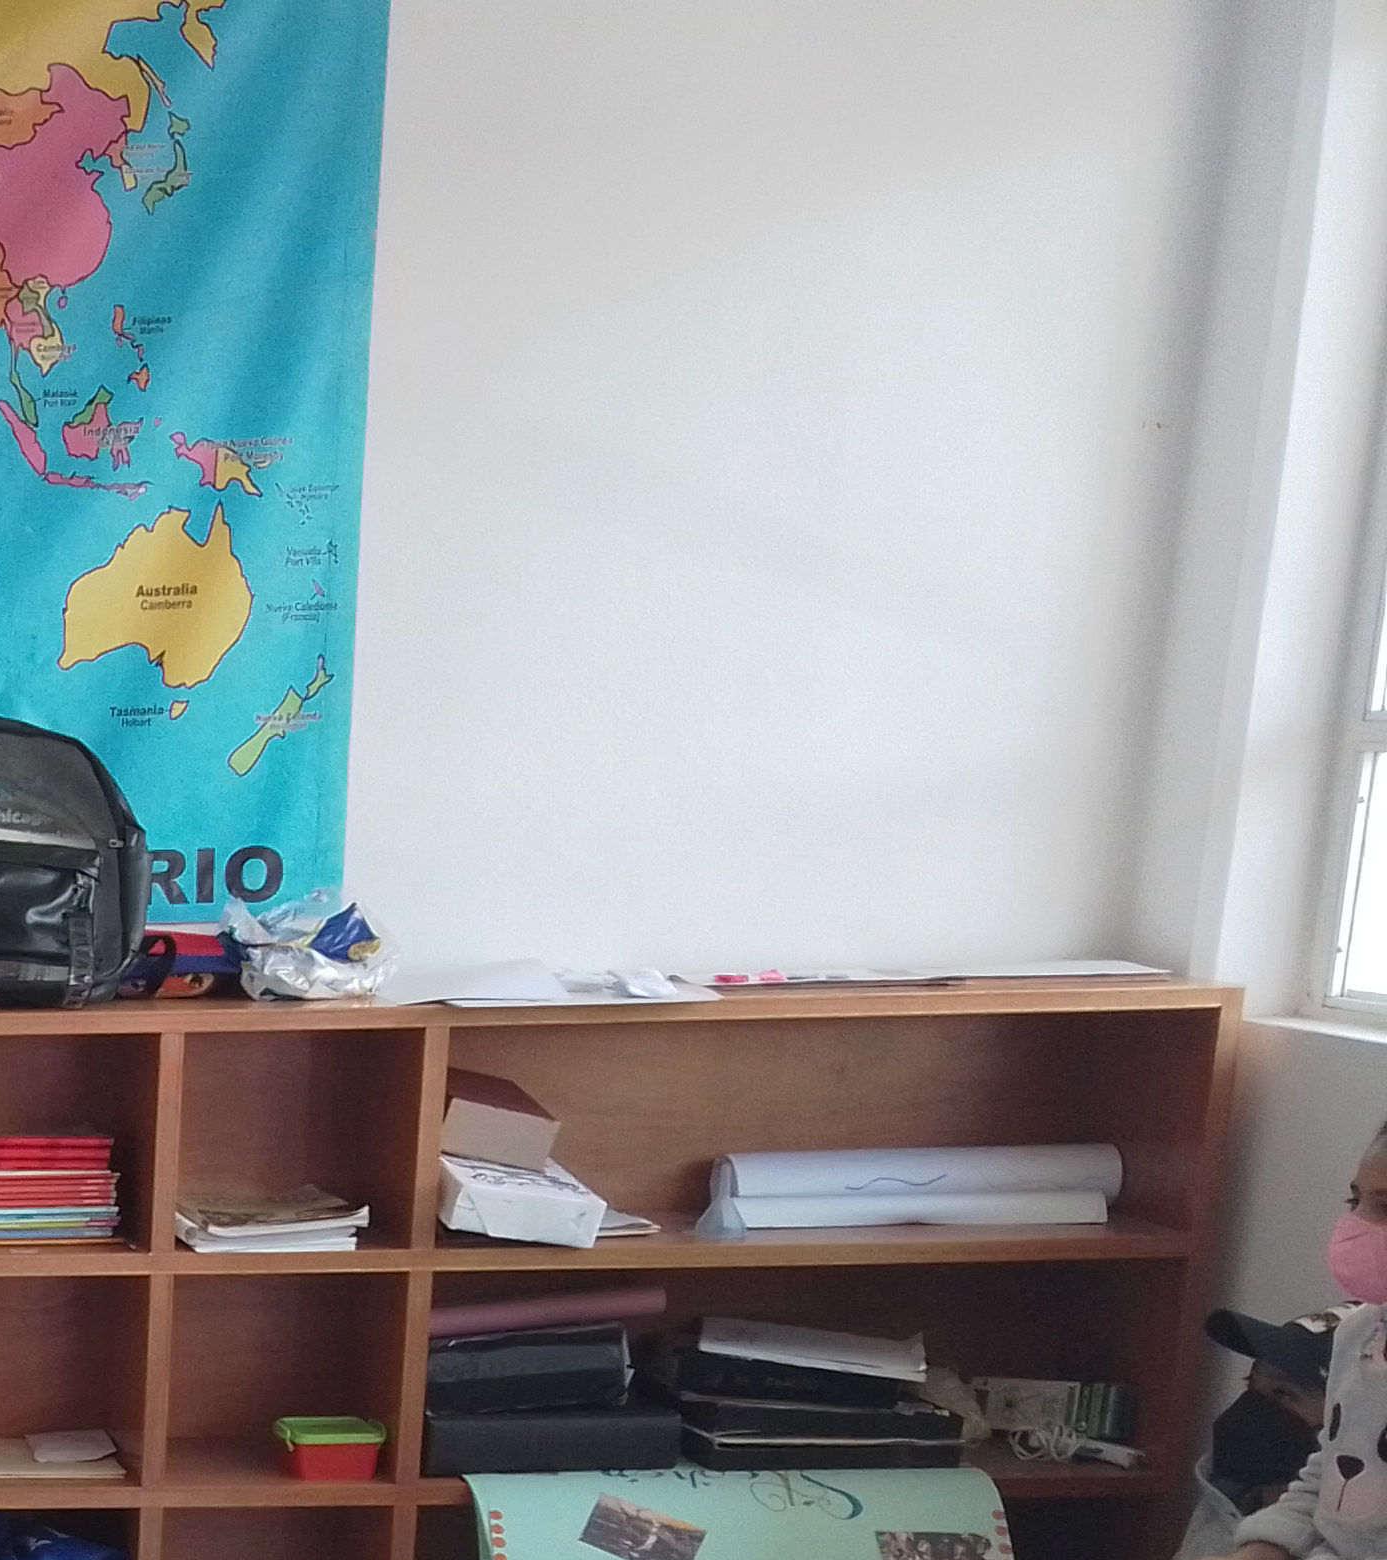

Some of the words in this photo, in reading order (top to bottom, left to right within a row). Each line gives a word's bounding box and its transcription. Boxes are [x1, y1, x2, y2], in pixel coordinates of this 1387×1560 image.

[82, 424, 140, 438] Indonesia
[135, 582, 199, 599] Australia
[139, 598, 193, 612] Camberra
[109, 705, 165, 718] Tasmania
